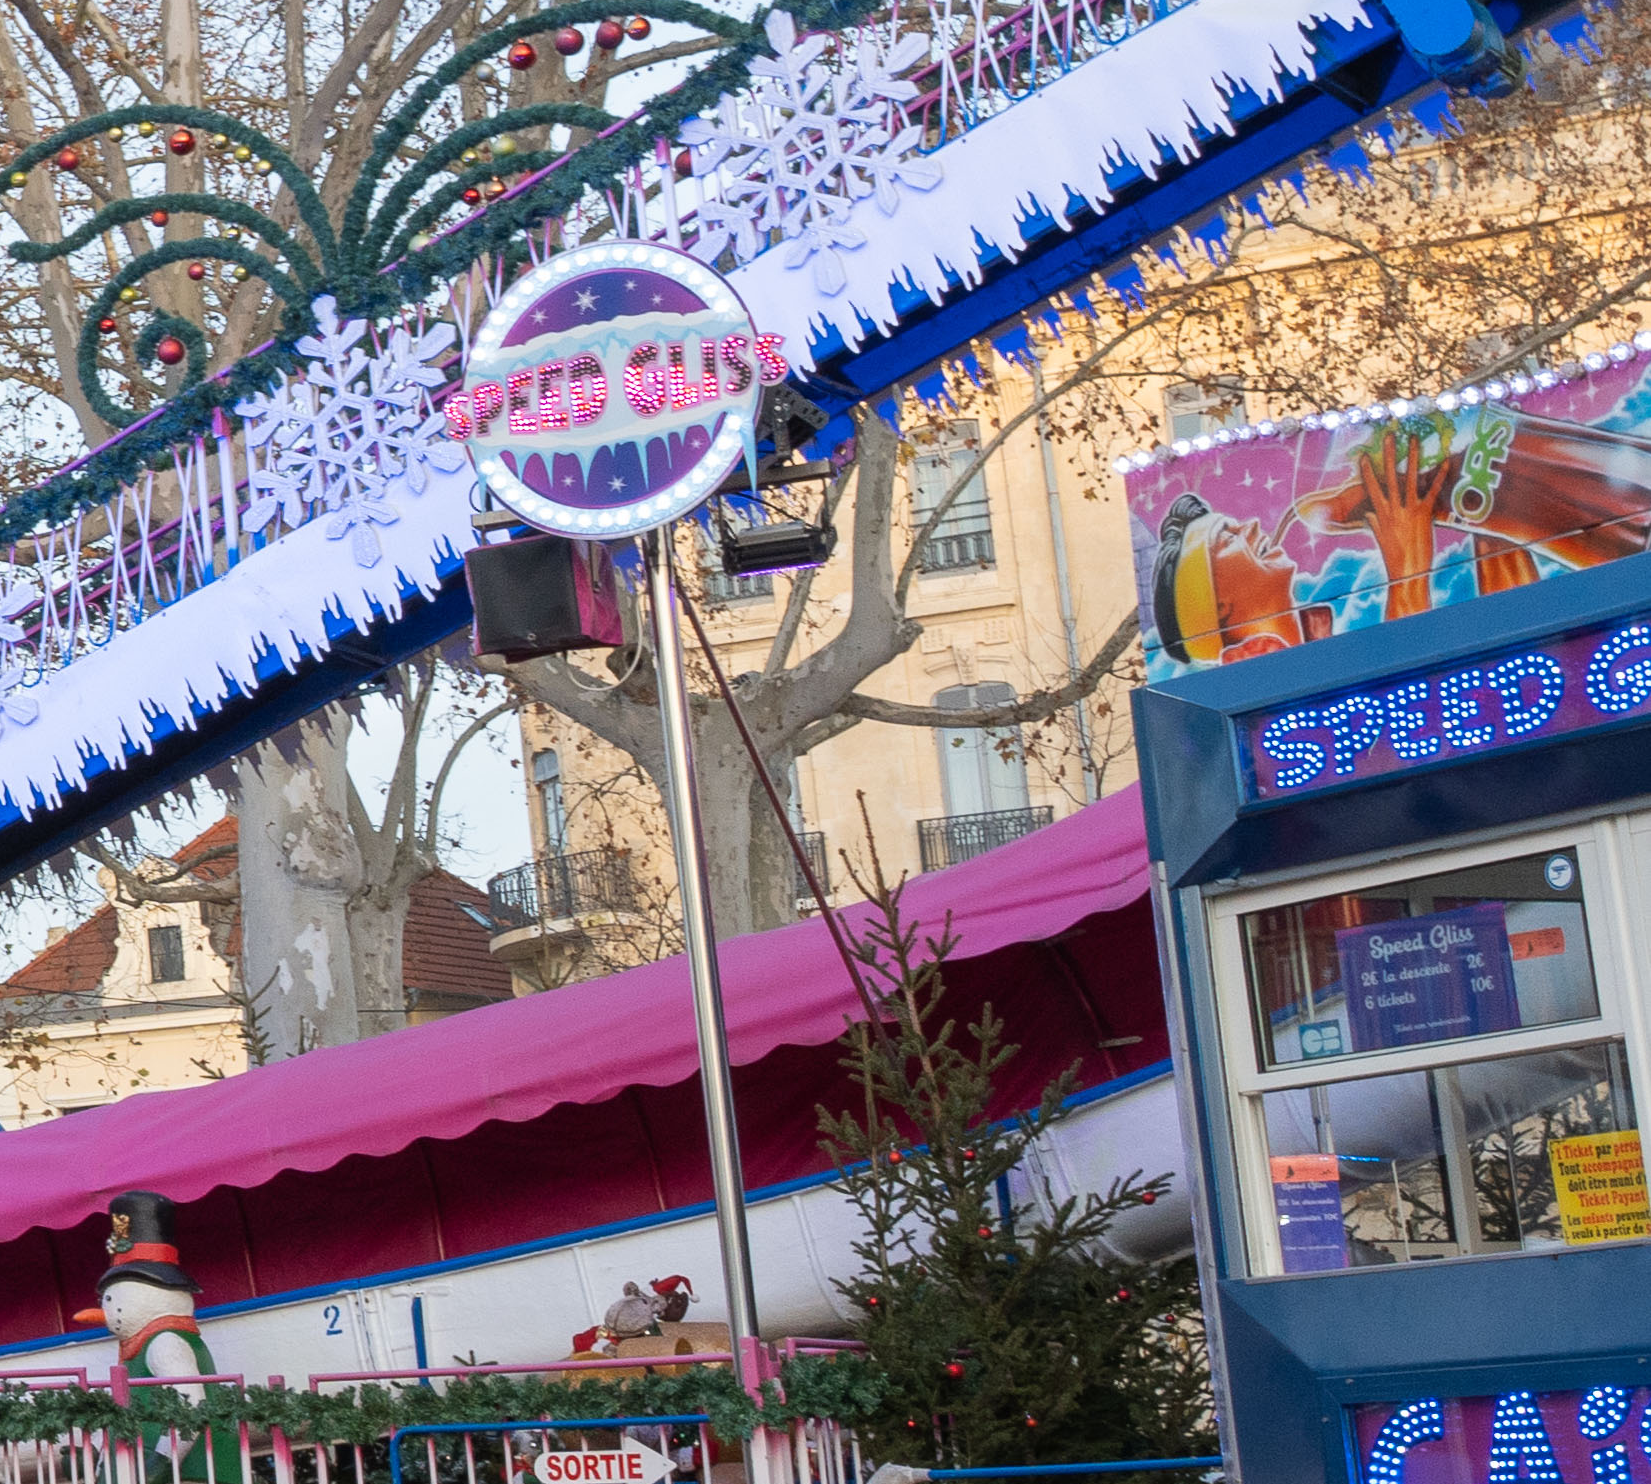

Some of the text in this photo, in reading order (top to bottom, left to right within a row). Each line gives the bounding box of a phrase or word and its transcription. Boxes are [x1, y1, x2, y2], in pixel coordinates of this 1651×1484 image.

[442, 331, 790, 442] SPEED GLISS
[1262, 652, 1566, 790] SPEED
[1368, 923, 1475, 962] Speed Gliss
[1382, 969, 1397, 983] la
[1399, 961, 1452, 981] descente
[1466, 952, 1485, 970] 2€
[1364, 975, 1495, 1010] 6 tickets 10€
[1562, 1143, 1594, 1158] Ticket
[1595, 1144, 1612, 1158] par
[1558, 1161, 1582, 1176] Tout
[1568, 1177, 1588, 1192] doit
[1588, 1176, 1608, 1190] être
[1609, 1174, 1634, 1188] muni
[1578, 1190, 1646, 1208] Ticket Payant
[1566, 1214, 1581, 1226] Les
[1582, 1212, 1615, 1225] enfants
[1571, 1227, 1594, 1240] seuls
[1603, 1224, 1631, 1239] partir
[1633, 1222, 1644, 1236] de
[323, 1304, 343, 1336] 2
[547, 1453, 643, 1481] SORTIE
